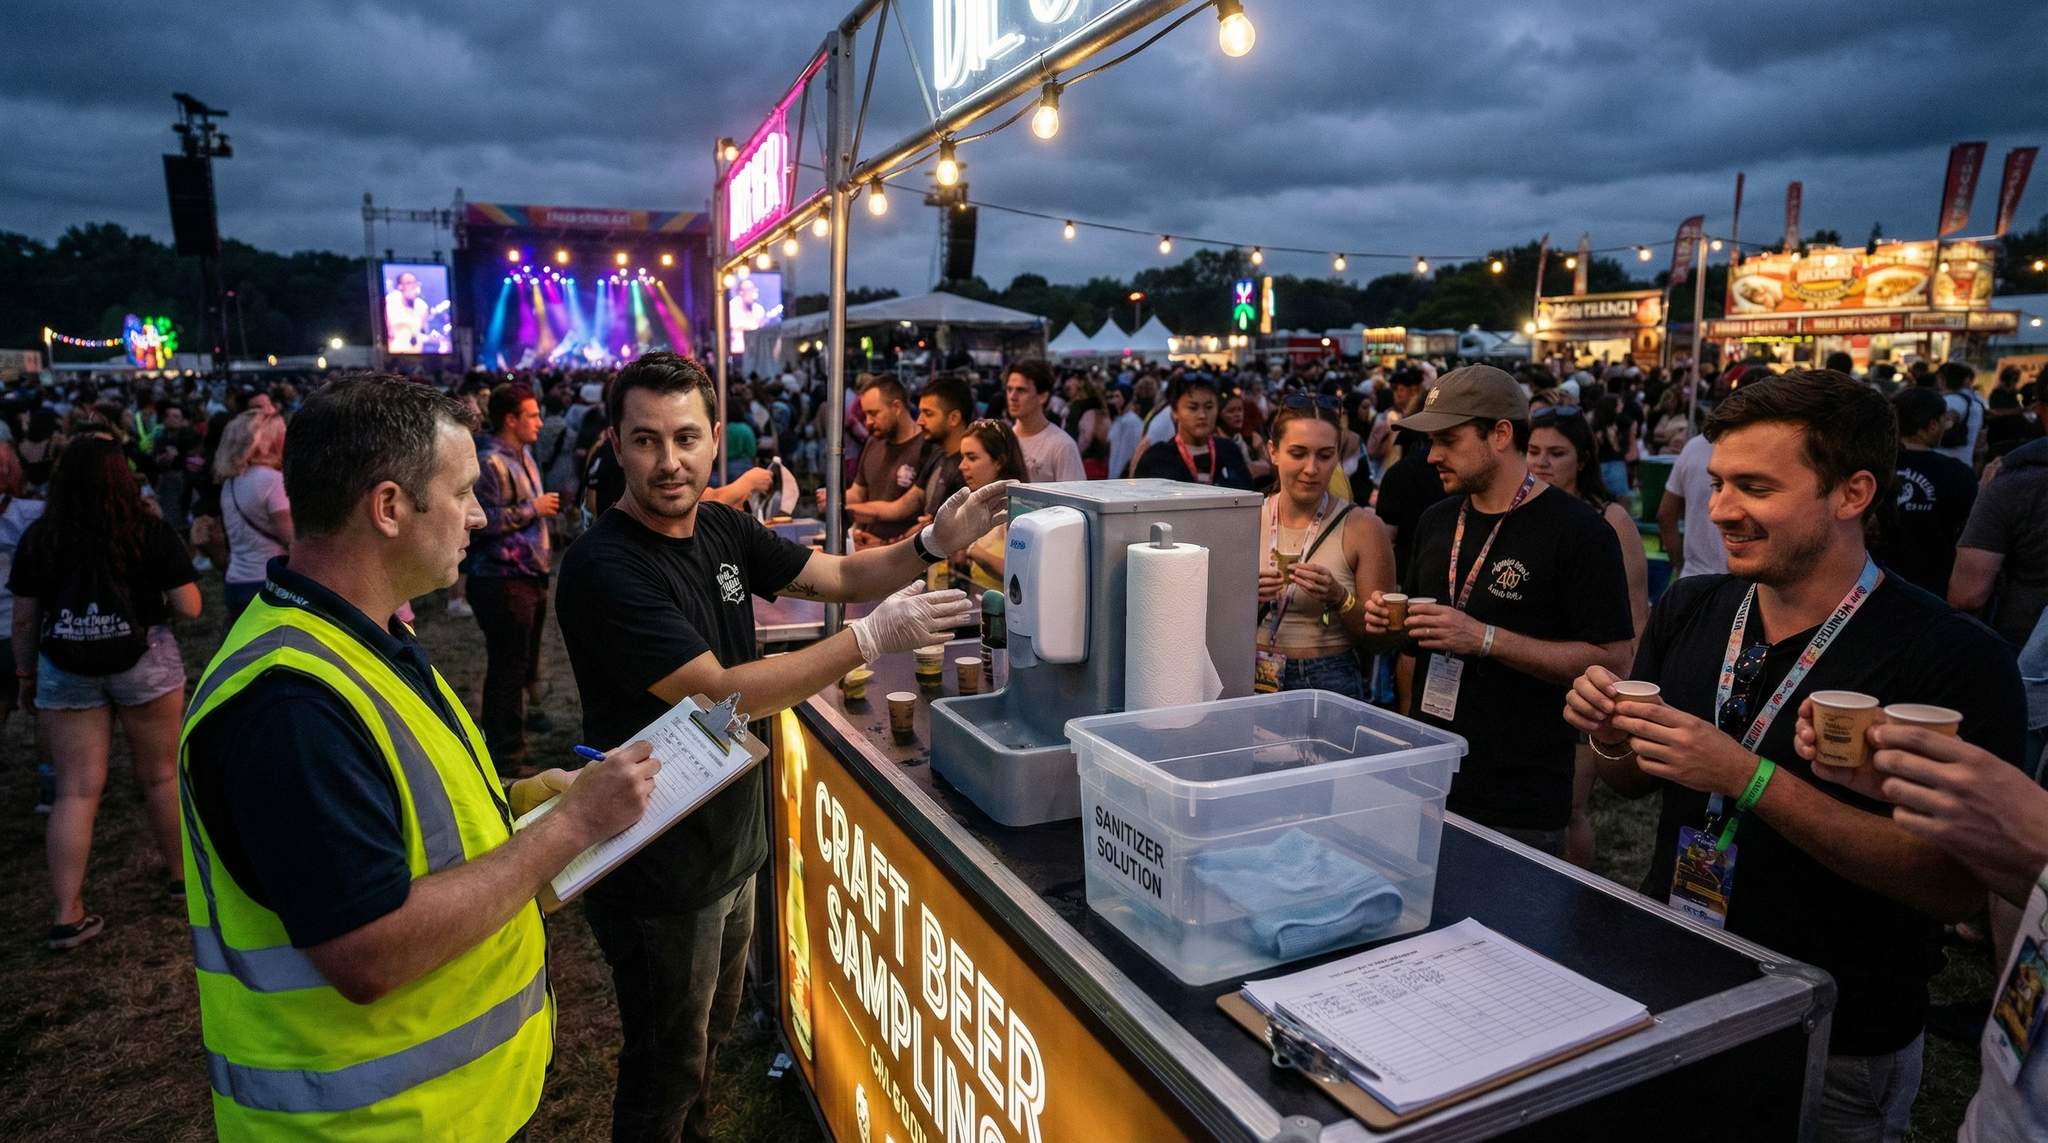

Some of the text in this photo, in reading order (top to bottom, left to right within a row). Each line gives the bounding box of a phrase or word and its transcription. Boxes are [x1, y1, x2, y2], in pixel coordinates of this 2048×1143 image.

[1095, 805, 1165, 869] SANITIZER
[1097, 836, 1163, 899] SOLUTION
[815, 780, 1046, 1143] CRAFT BEER
[827, 884, 1006, 1143] SAMPLIN
